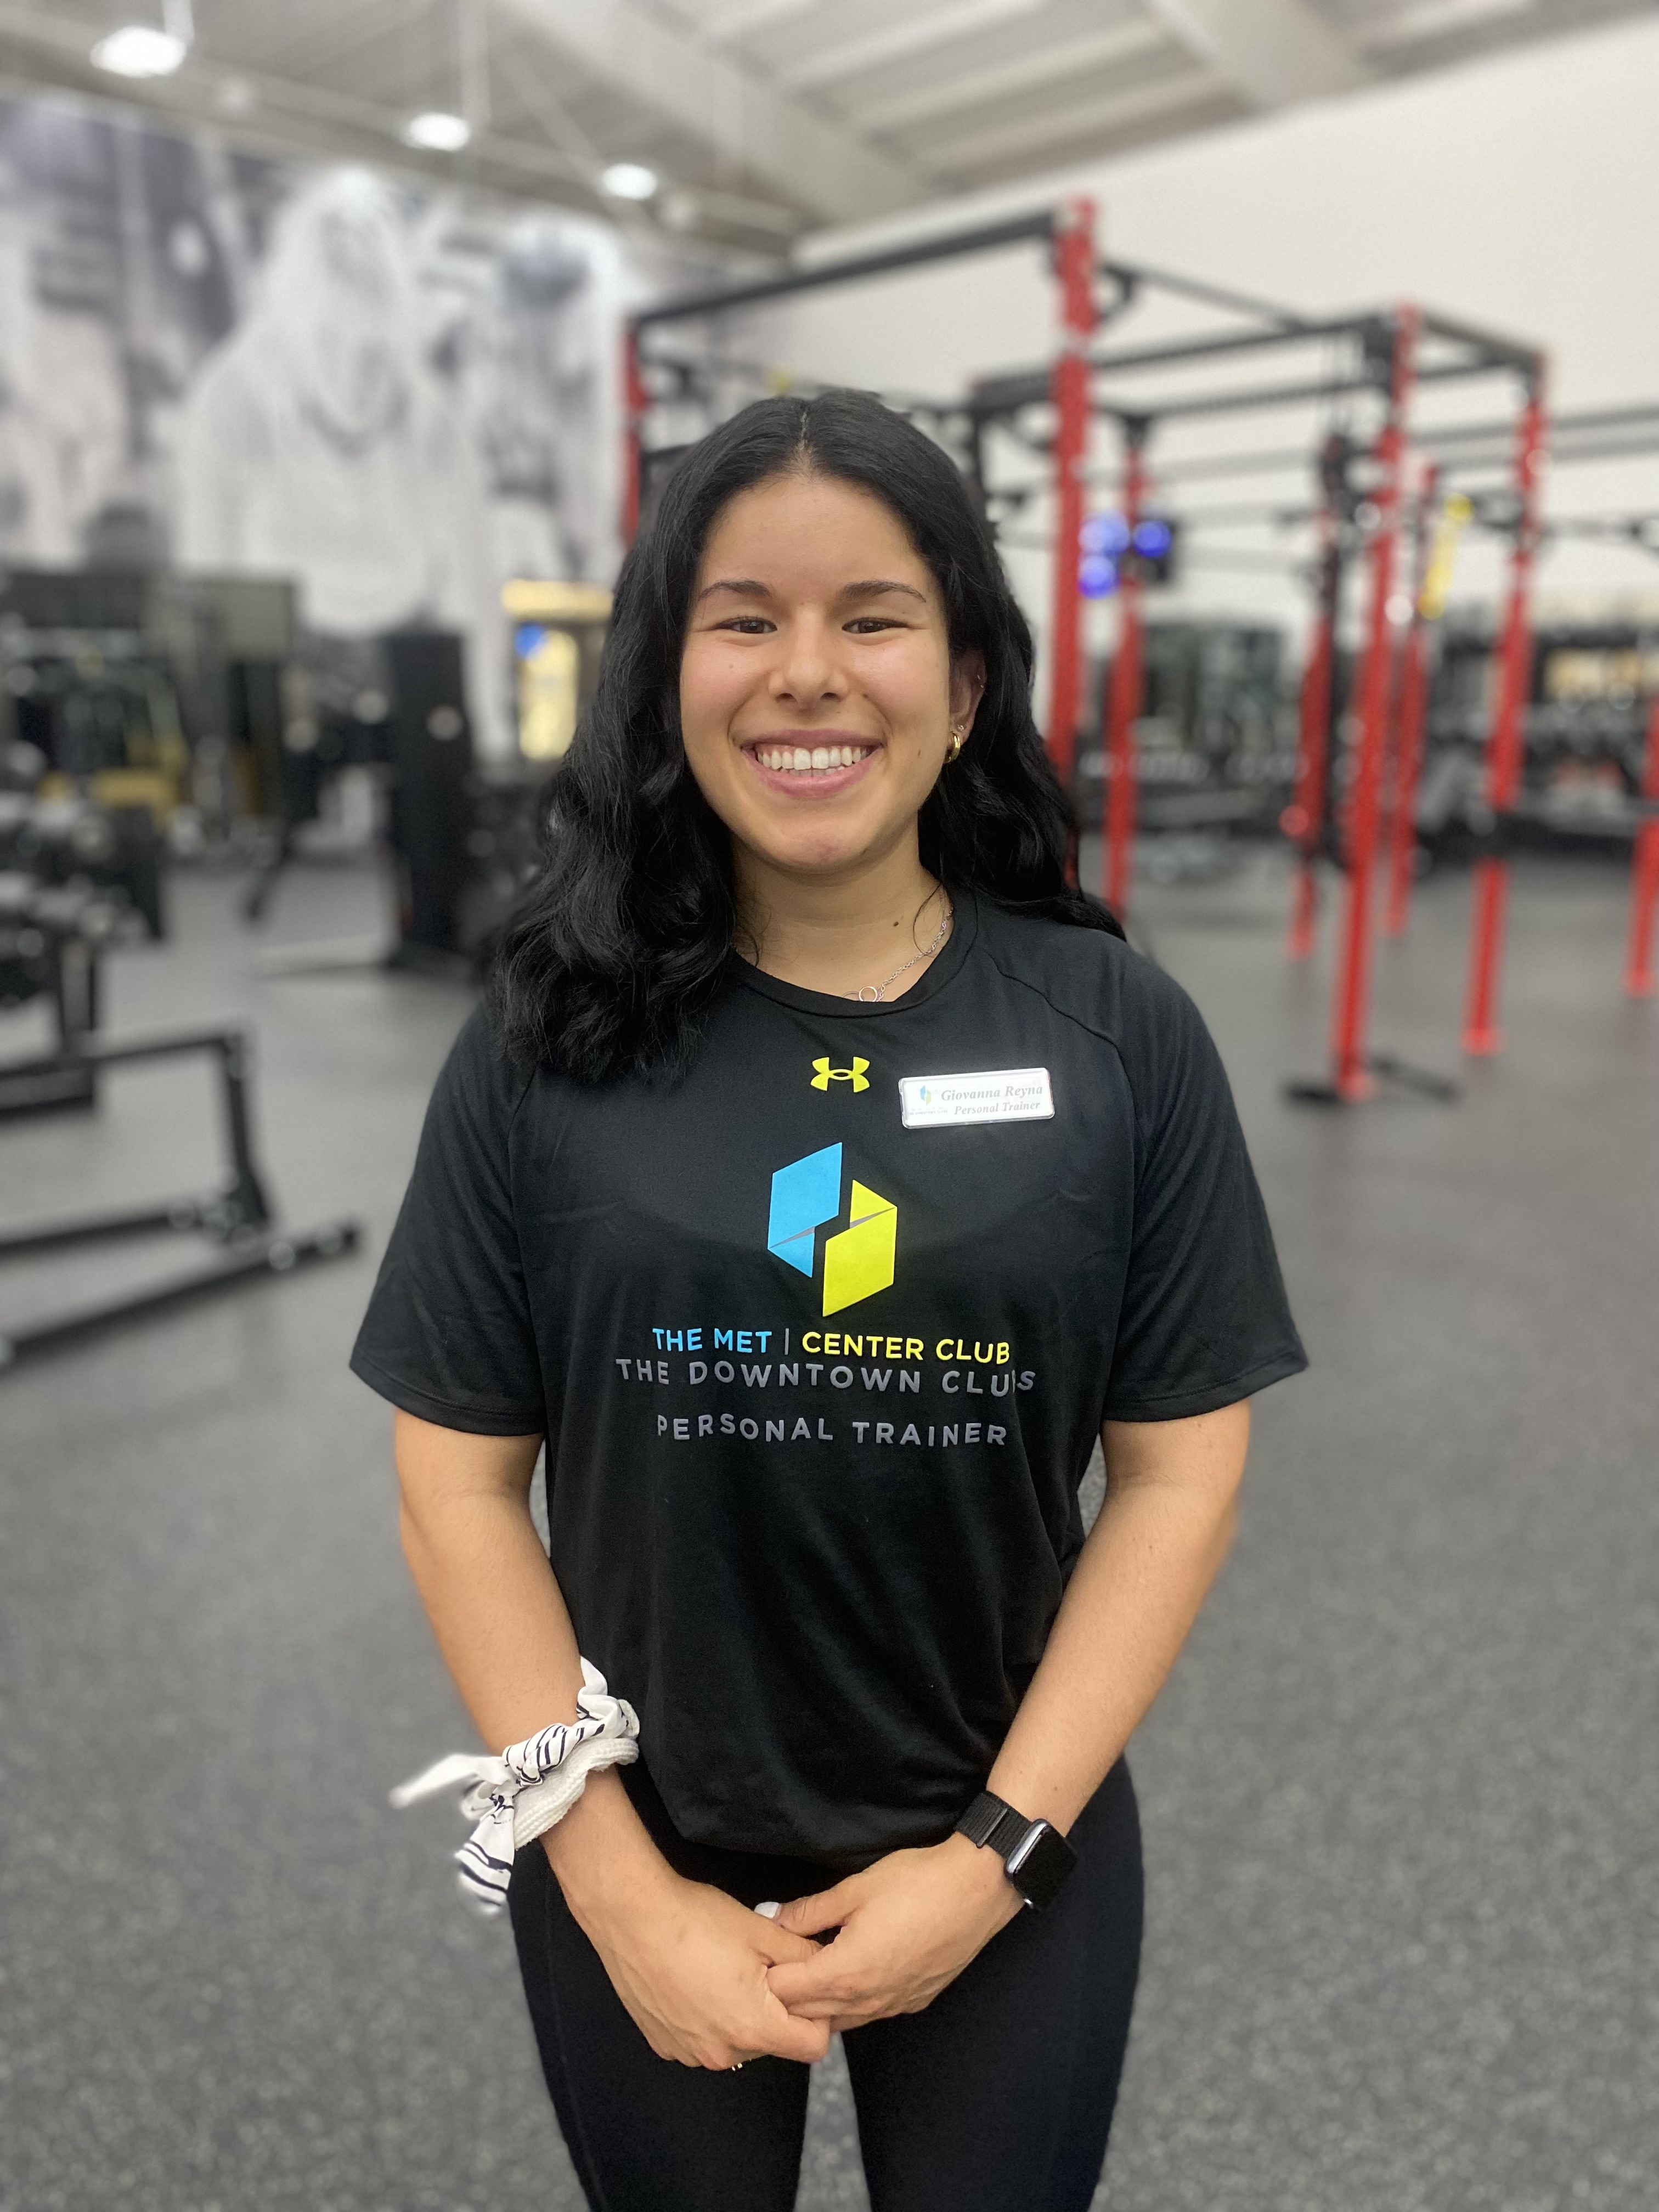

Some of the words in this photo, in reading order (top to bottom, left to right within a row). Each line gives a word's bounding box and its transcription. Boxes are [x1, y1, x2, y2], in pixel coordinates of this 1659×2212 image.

[941, 1088, 1000, 1101] Giovanna
[1005, 1085, 1043, 1098] Reyna
[954, 1104, 998, 1115] Personal
[1002, 1101, 1041, 1112] Trainer
[652, 1328, 703, 1352] THE
[714, 1328, 772, 1353] MET
[802, 1331, 924, 1361] CENTER
[935, 1339, 1010, 1365] CLUB
[615, 1358, 670, 1385] THE
[689, 1360, 921, 1393] DOWNTOWN
[941, 1369, 1036, 1397] CLUS
[657, 1413, 833, 1442] PERSONAL
[851, 1421, 1007, 1448] TRAINER
